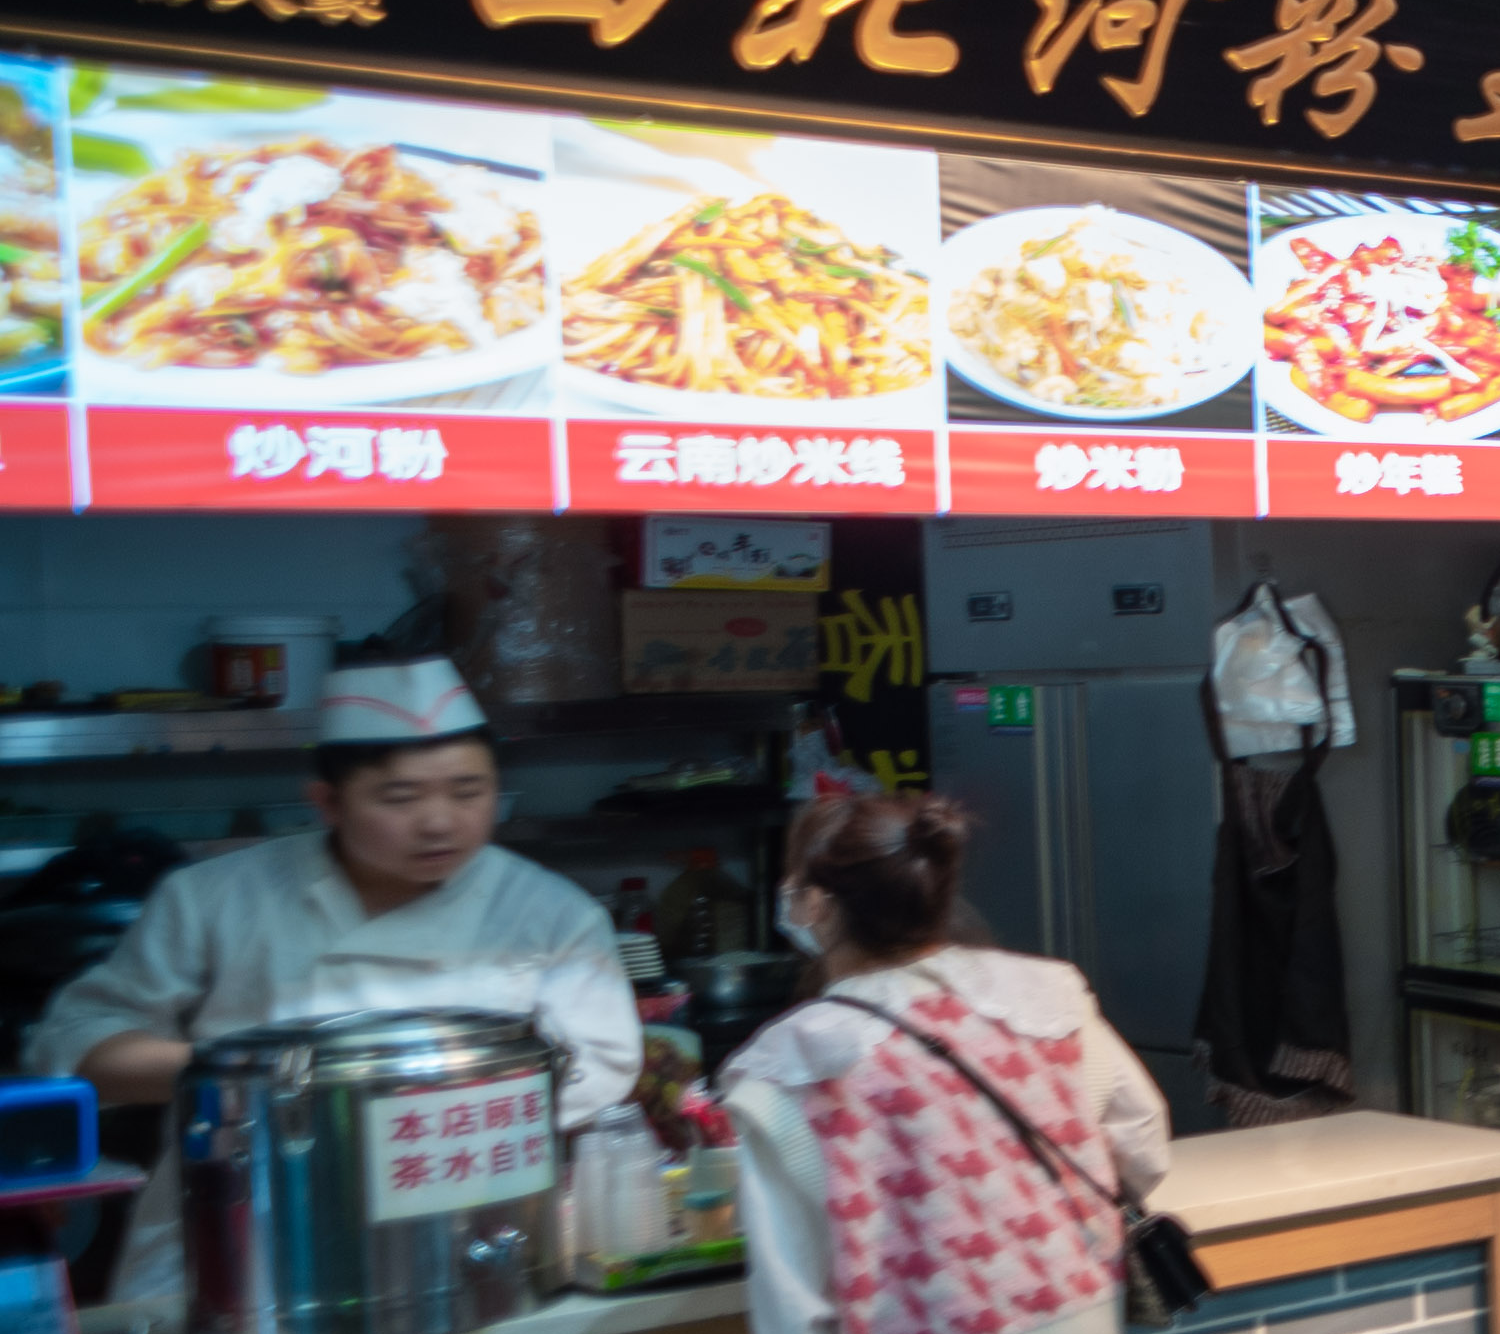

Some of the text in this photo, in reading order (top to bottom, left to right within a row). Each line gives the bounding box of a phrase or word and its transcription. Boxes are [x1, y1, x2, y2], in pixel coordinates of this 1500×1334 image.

[228, 421, 447, 482] 炒河粉
[616, 431, 906, 487] 云南炒米线
[1035, 444, 1185, 495] 炒米粉
[1334, 451, 1465, 497] 炒年糕
